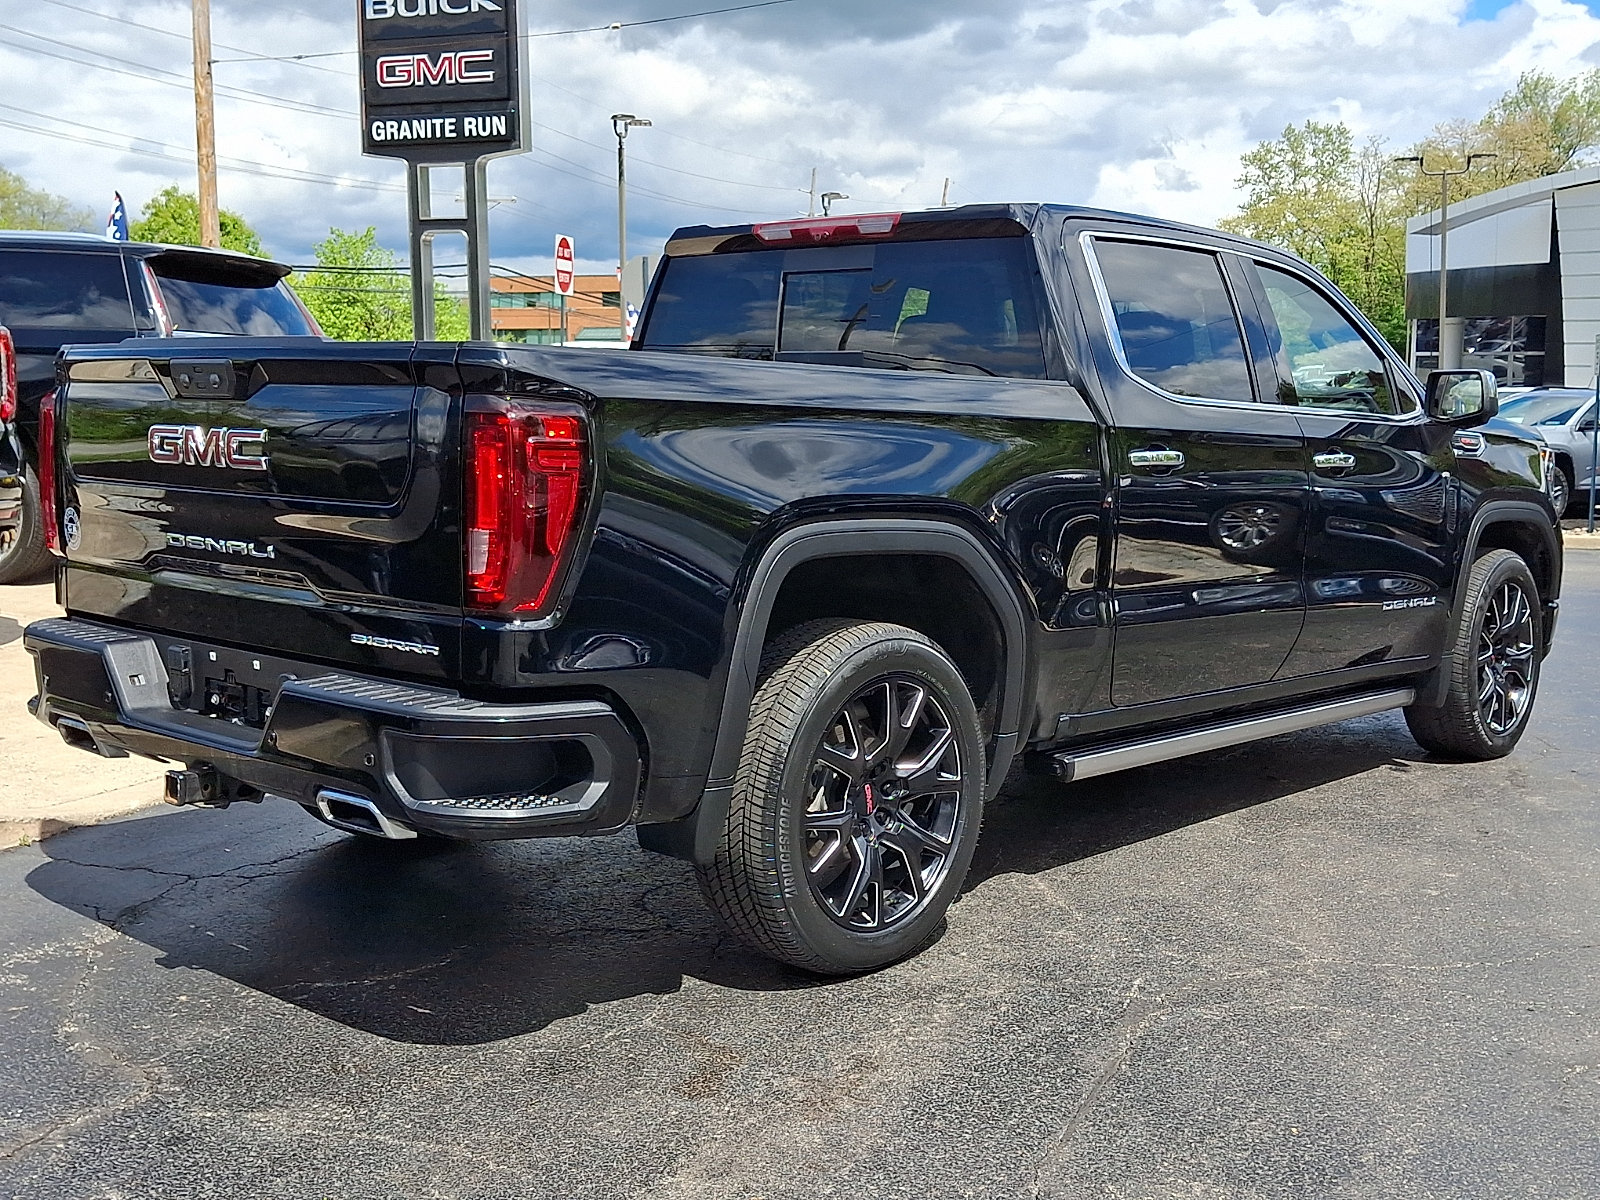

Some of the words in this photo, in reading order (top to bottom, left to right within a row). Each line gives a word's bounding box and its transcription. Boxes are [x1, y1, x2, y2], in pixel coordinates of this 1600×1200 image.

[376, 49, 495, 88] GMC
[371, 118, 457, 141] GRANITE
[464, 115, 506, 137] RUN
[148, 424, 270, 471] GMC
[166, 532, 275, 559] DENALI
[1382, 596, 1436, 611] DENALI
[350, 633, 440, 656] SIERRA
[779, 797, 798, 899] BRIDGESTONE
